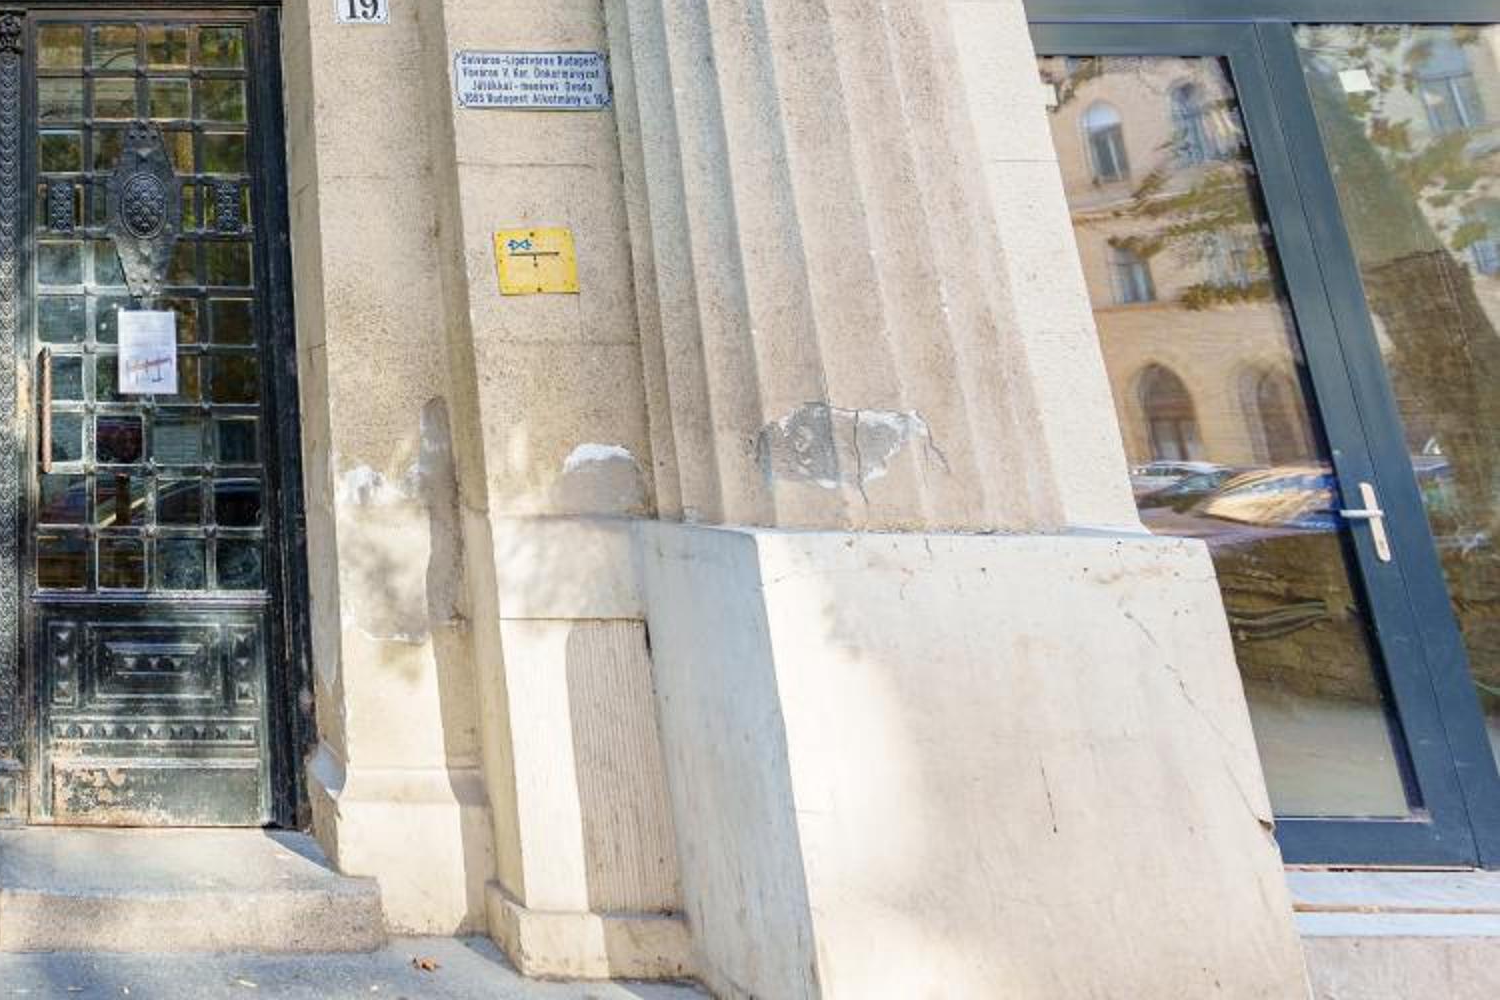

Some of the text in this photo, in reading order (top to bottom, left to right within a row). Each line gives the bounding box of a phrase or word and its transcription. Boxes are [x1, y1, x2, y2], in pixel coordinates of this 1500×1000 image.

[557, 55, 598, 68] Budapest
[486, 93, 530, 105] Budapest
[532, 93, 581, 106] Alkotmány
